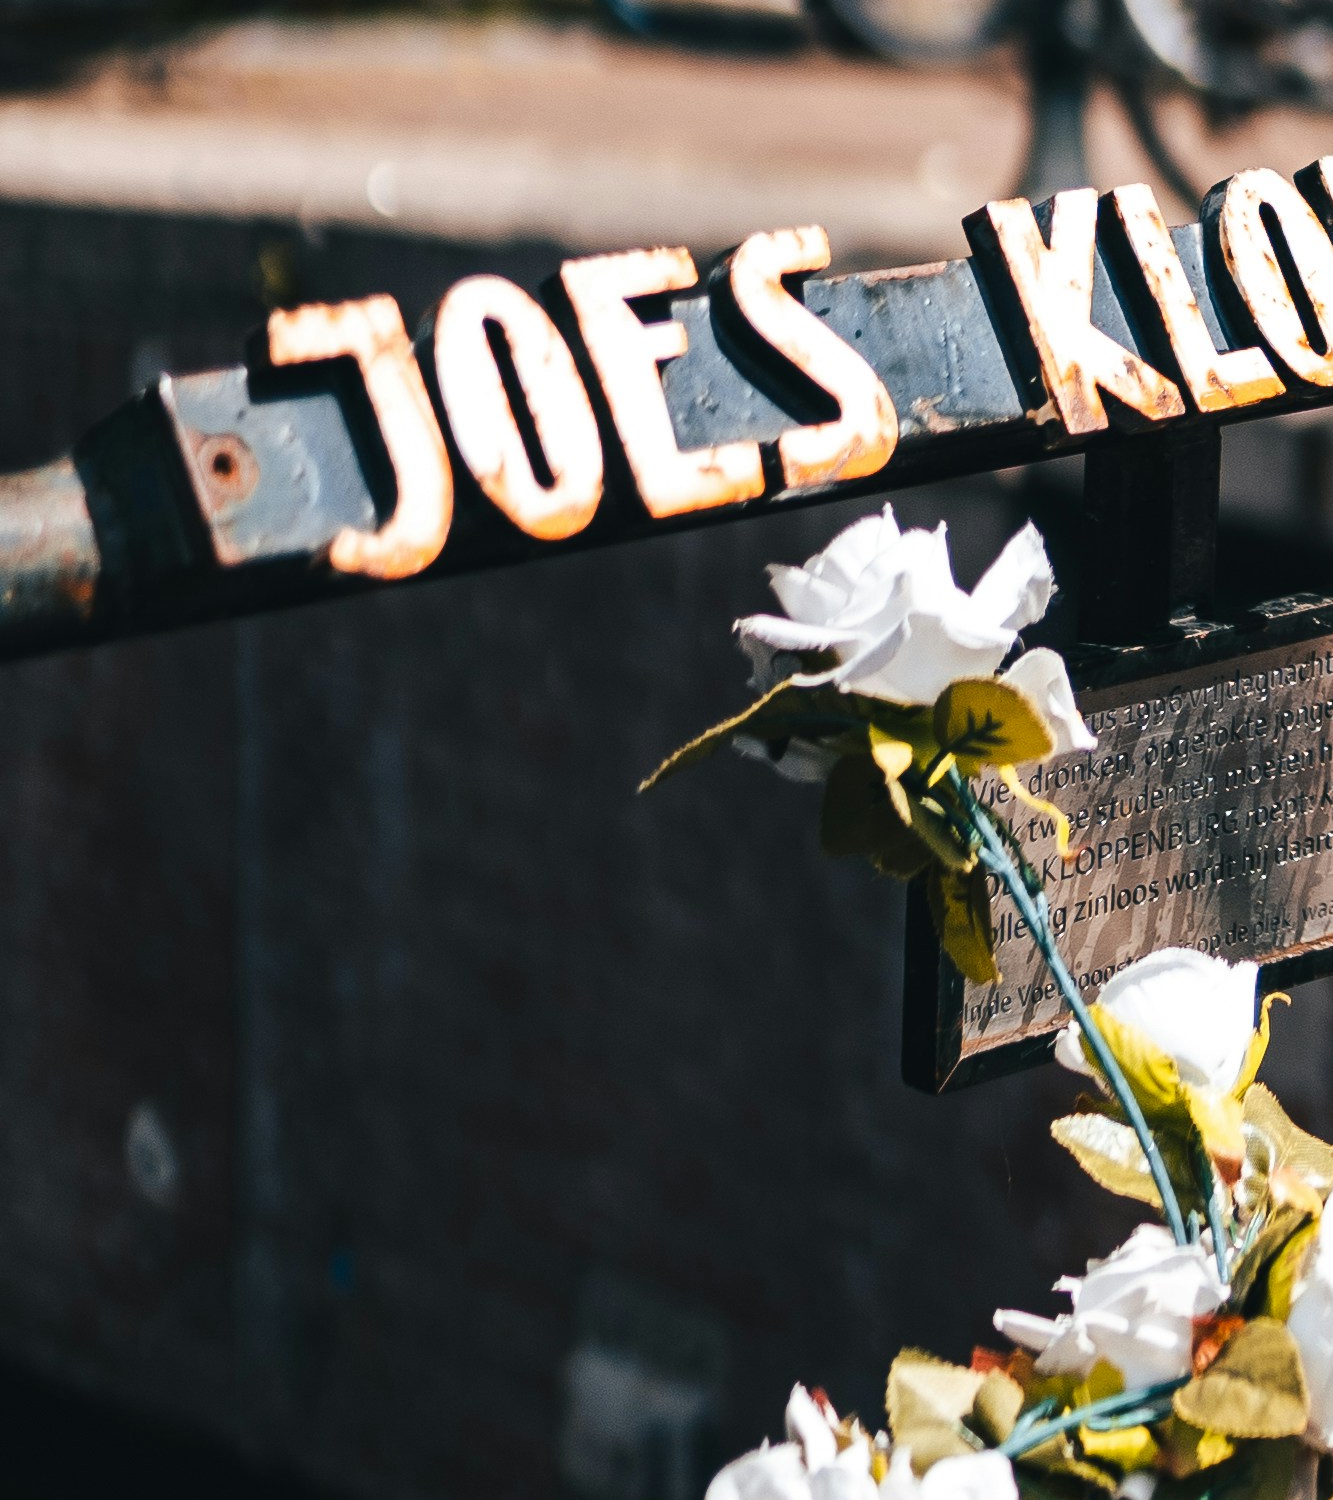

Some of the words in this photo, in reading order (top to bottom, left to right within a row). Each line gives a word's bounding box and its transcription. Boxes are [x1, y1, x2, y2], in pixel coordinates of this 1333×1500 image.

[266, 222, 899, 581] JOES
[1122, 685, 1184, 731] 1996
[1189, 652, 1333, 708] vrijdagnacht
[1028, 751, 1136, 797] dronken,
[1145, 714, 1268, 769] opgefokte
[1096, 774, 1218, 826] studenten
[1225, 747, 1314, 791] moeten
[1042, 806, 1238, 884] KLOPPENBURG
[1074, 880, 1159, 923] zinloos
[1166, 853, 1236, 895] wordt
[1242, 844, 1268, 880] hij
[964, 1001, 982, 1024] In
[986, 993, 1011, 1020] de
[1225, 921, 1248, 946] de
